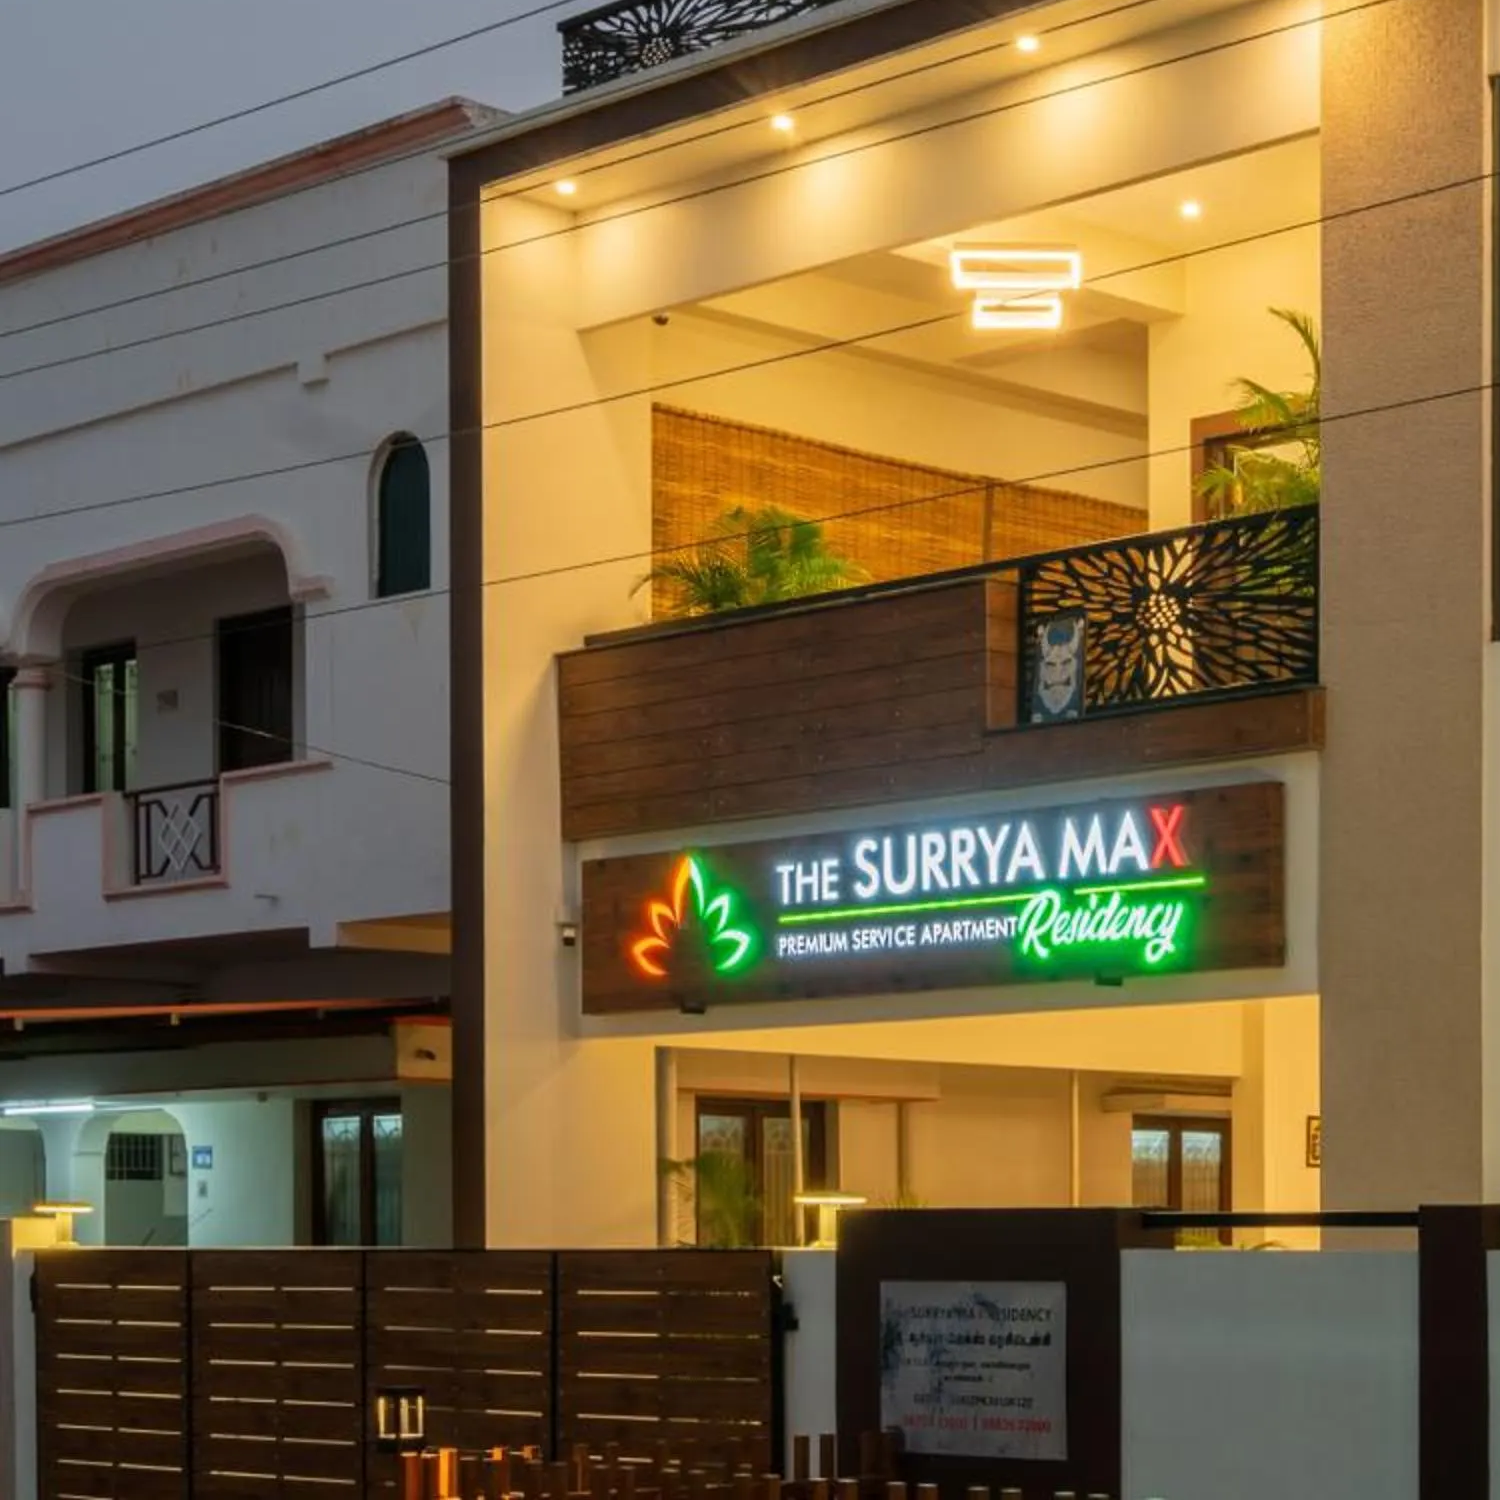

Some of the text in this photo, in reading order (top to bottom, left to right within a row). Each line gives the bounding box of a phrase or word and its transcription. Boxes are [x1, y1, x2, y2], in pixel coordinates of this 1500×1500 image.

[776, 804, 1187, 905] THE SURRYA MAX
[779, 915, 1018, 957] PREMIUM SERVICE APARTMENT
[1017, 889, 1184, 963] Residency
